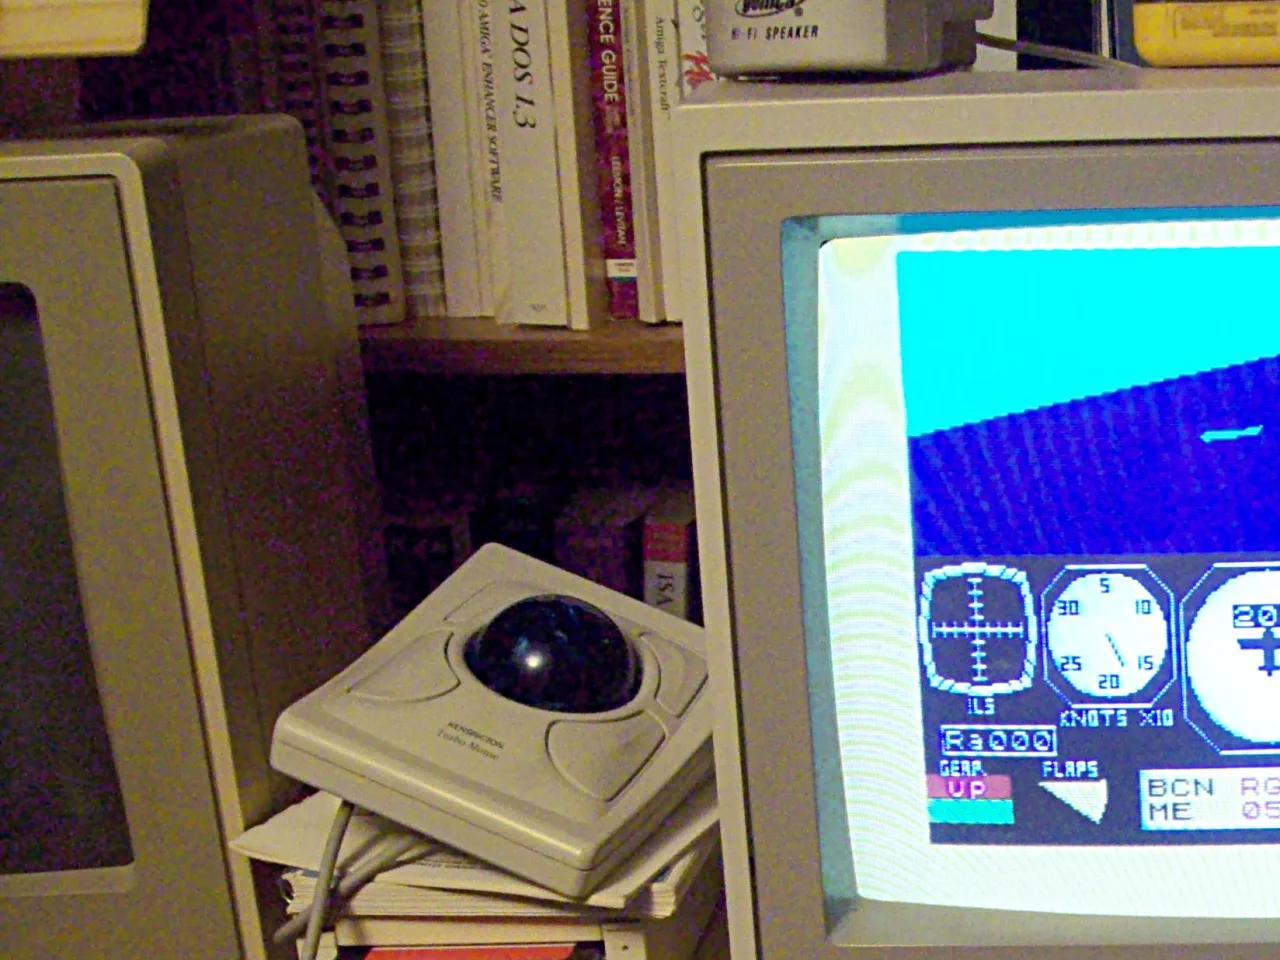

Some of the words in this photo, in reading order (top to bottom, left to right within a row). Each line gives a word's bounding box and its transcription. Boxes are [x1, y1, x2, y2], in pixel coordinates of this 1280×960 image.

[655, 16, 668, 54] Amiga
[765, 25, 819, 40] SPEAKER
[511, 23, 532, 84] DOS
[601, 50, 618, 105] GUIDE
[482, 61, 497, 131] ENHANCER
[513, 92, 536, 129] 1.3
[486, 134, 502, 200] SOFTWARE
[1100, 578, 1110, 593] 5
[1059, 600, 1080, 615] 30
[1135, 600, 1151, 615] 10
[1061, 656, 1082, 671] 25
[1138, 655, 1154, 670] 15
[1099, 674, 1120, 689] 20
[967, 698, 995, 715] ILS
[1060, 710, 1127, 727] KNOTS
[1139, 709, 1174, 726] X10
[447, 722, 504, 748] KENSINGTON
[940, 761, 987, 777] GEAR
[1042, 761, 1098, 777] FLAPS
[948, 781, 986, 799] UP
[1148, 778, 1214, 797] BCN
[1148, 802, 1192, 821] ME
